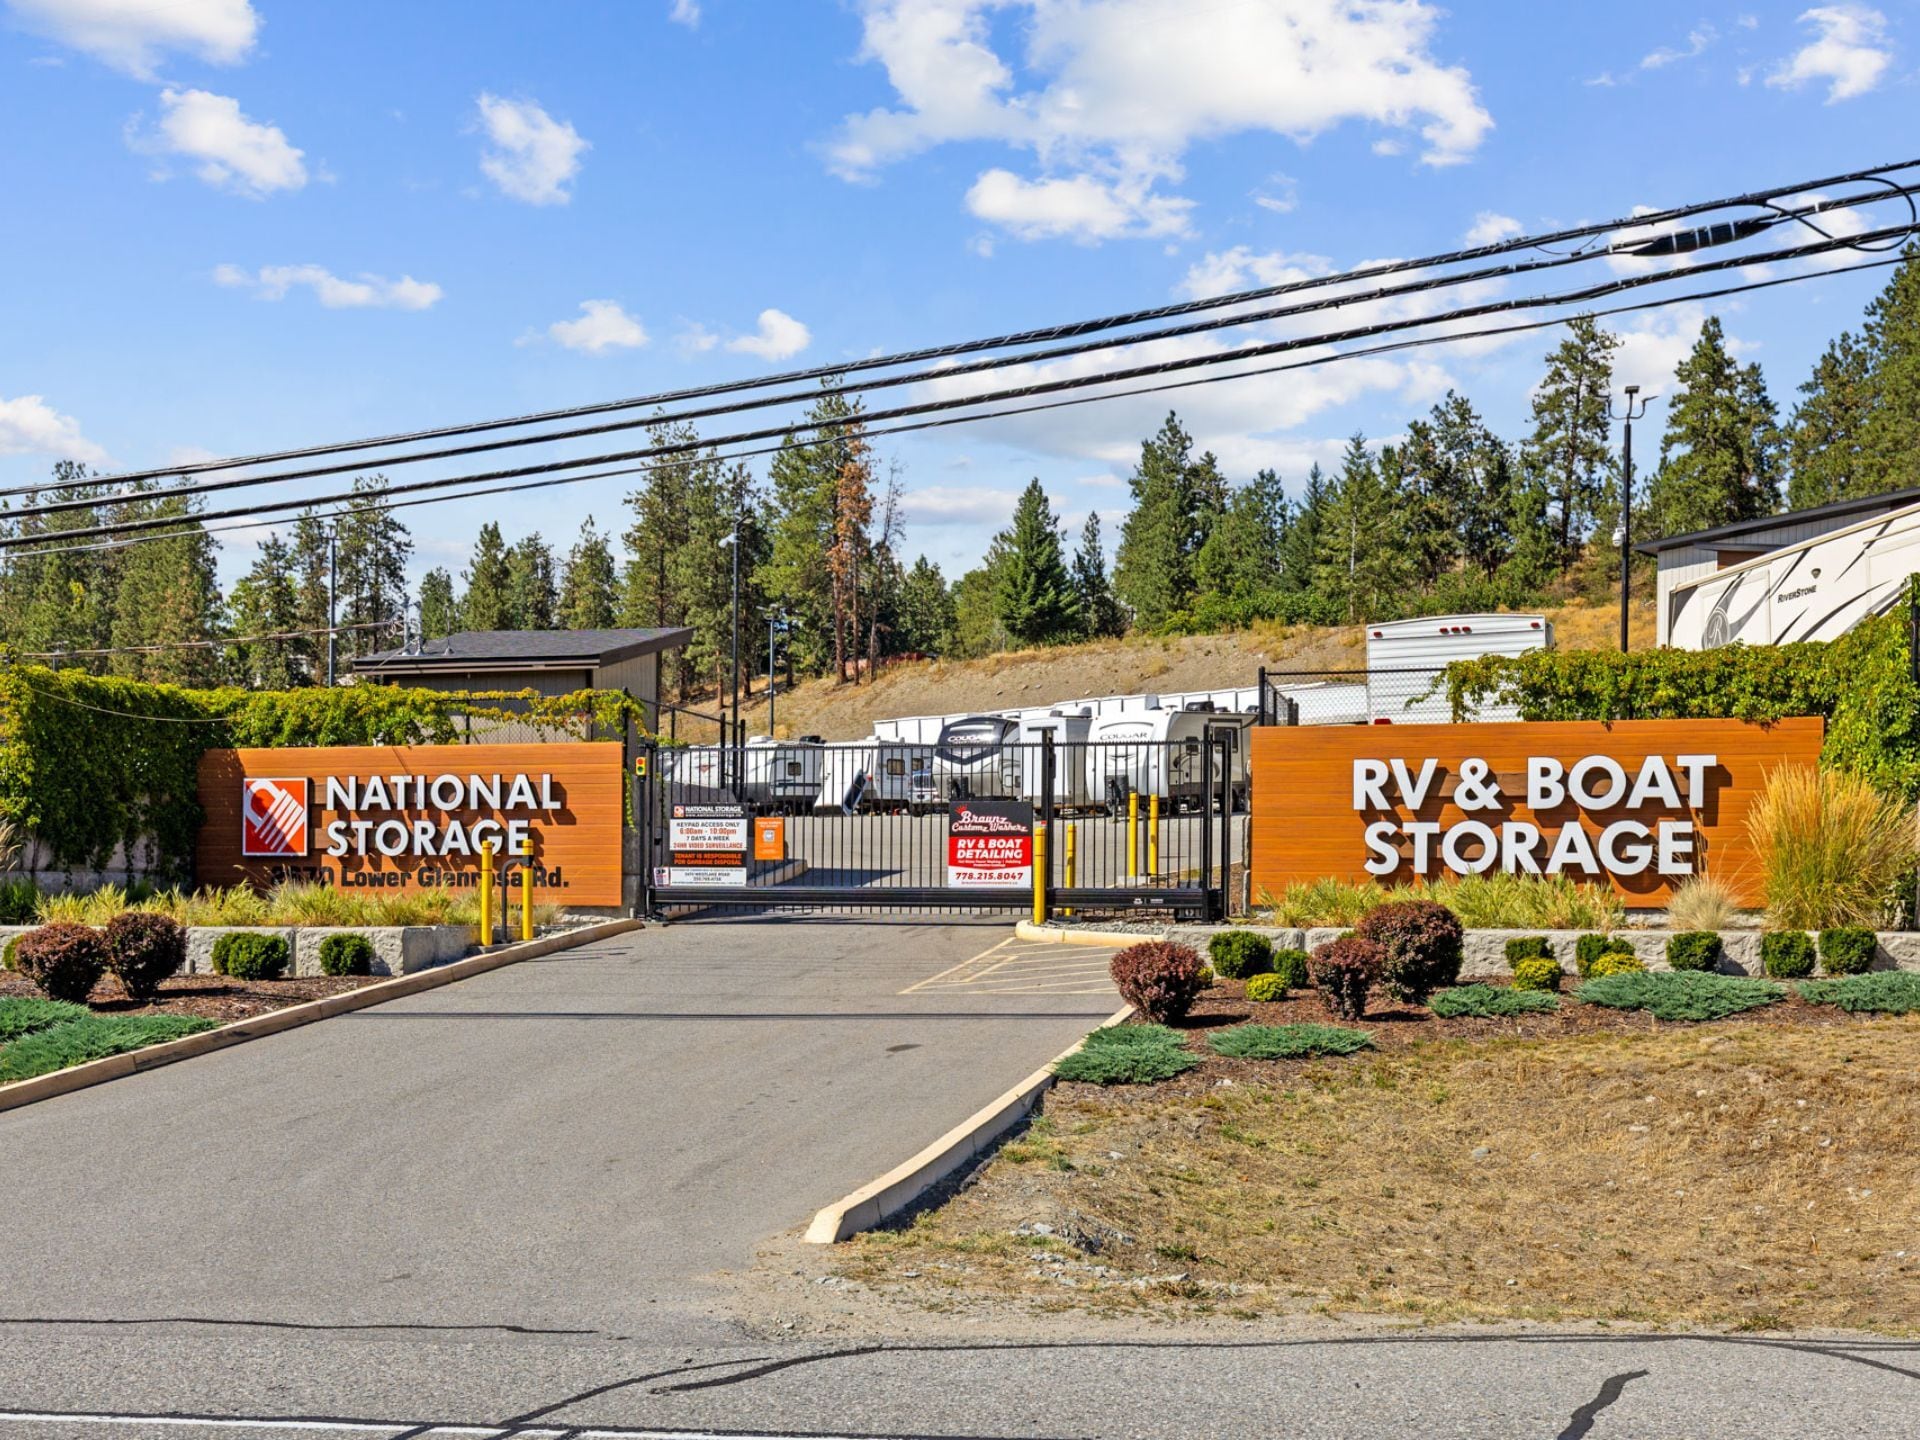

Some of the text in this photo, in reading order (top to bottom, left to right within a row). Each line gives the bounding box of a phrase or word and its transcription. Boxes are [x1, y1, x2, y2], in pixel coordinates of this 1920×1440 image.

[947, 735, 988, 743] COUG
[1100, 732, 1148, 741] COUGAR
[1353, 754, 1718, 811] RV & BOAT
[326, 773, 562, 811] NATIONAL
[958, 811, 1008, 824] Braunz
[951, 822, 1029, 833] Customz Washerz
[326, 819, 531, 857] STORAGE
[957, 839, 1023, 849] RV & BOAT
[957, 849, 1023, 859] DETAILING
[1363, 820, 1694, 876] STORAGE
[342, 866, 411, 887] Lower
[417, 866, 523, 887] Glenrsa
[531, 866, 569, 887] Rd.
[955, 872, 1024, 880] 778.215.8047
